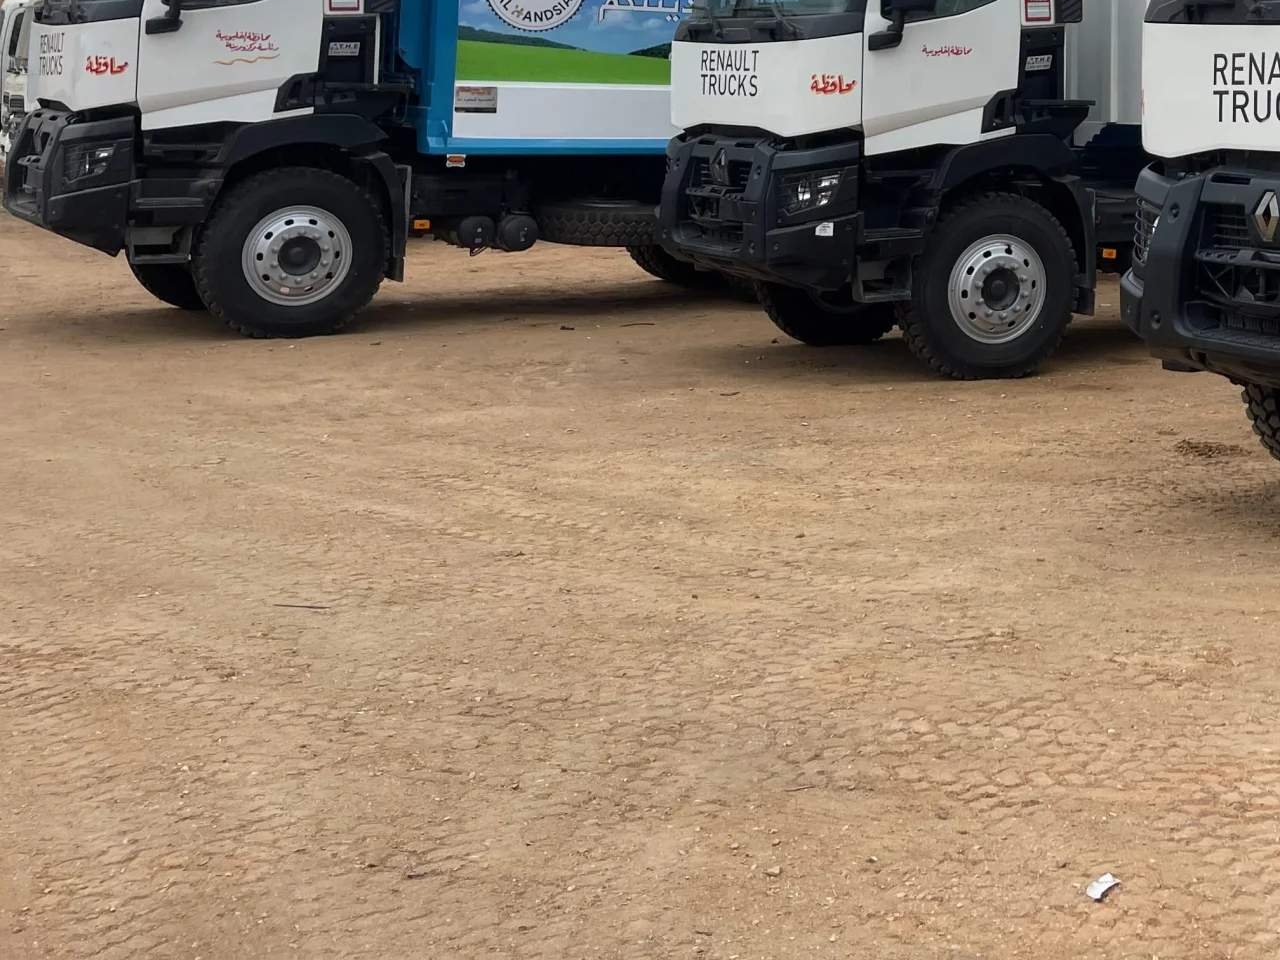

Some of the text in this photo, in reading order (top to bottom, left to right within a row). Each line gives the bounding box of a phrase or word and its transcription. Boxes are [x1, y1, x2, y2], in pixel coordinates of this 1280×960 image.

[40, 32, 65, 54] RENAULT
[39, 55, 63, 76] TRUCKS
[85, 55, 129, 76] محافظة
[701, 50, 759, 72] RENAULT
[701, 74, 758, 97] TRUCKS
[810, 73, 859, 96] محافظة
